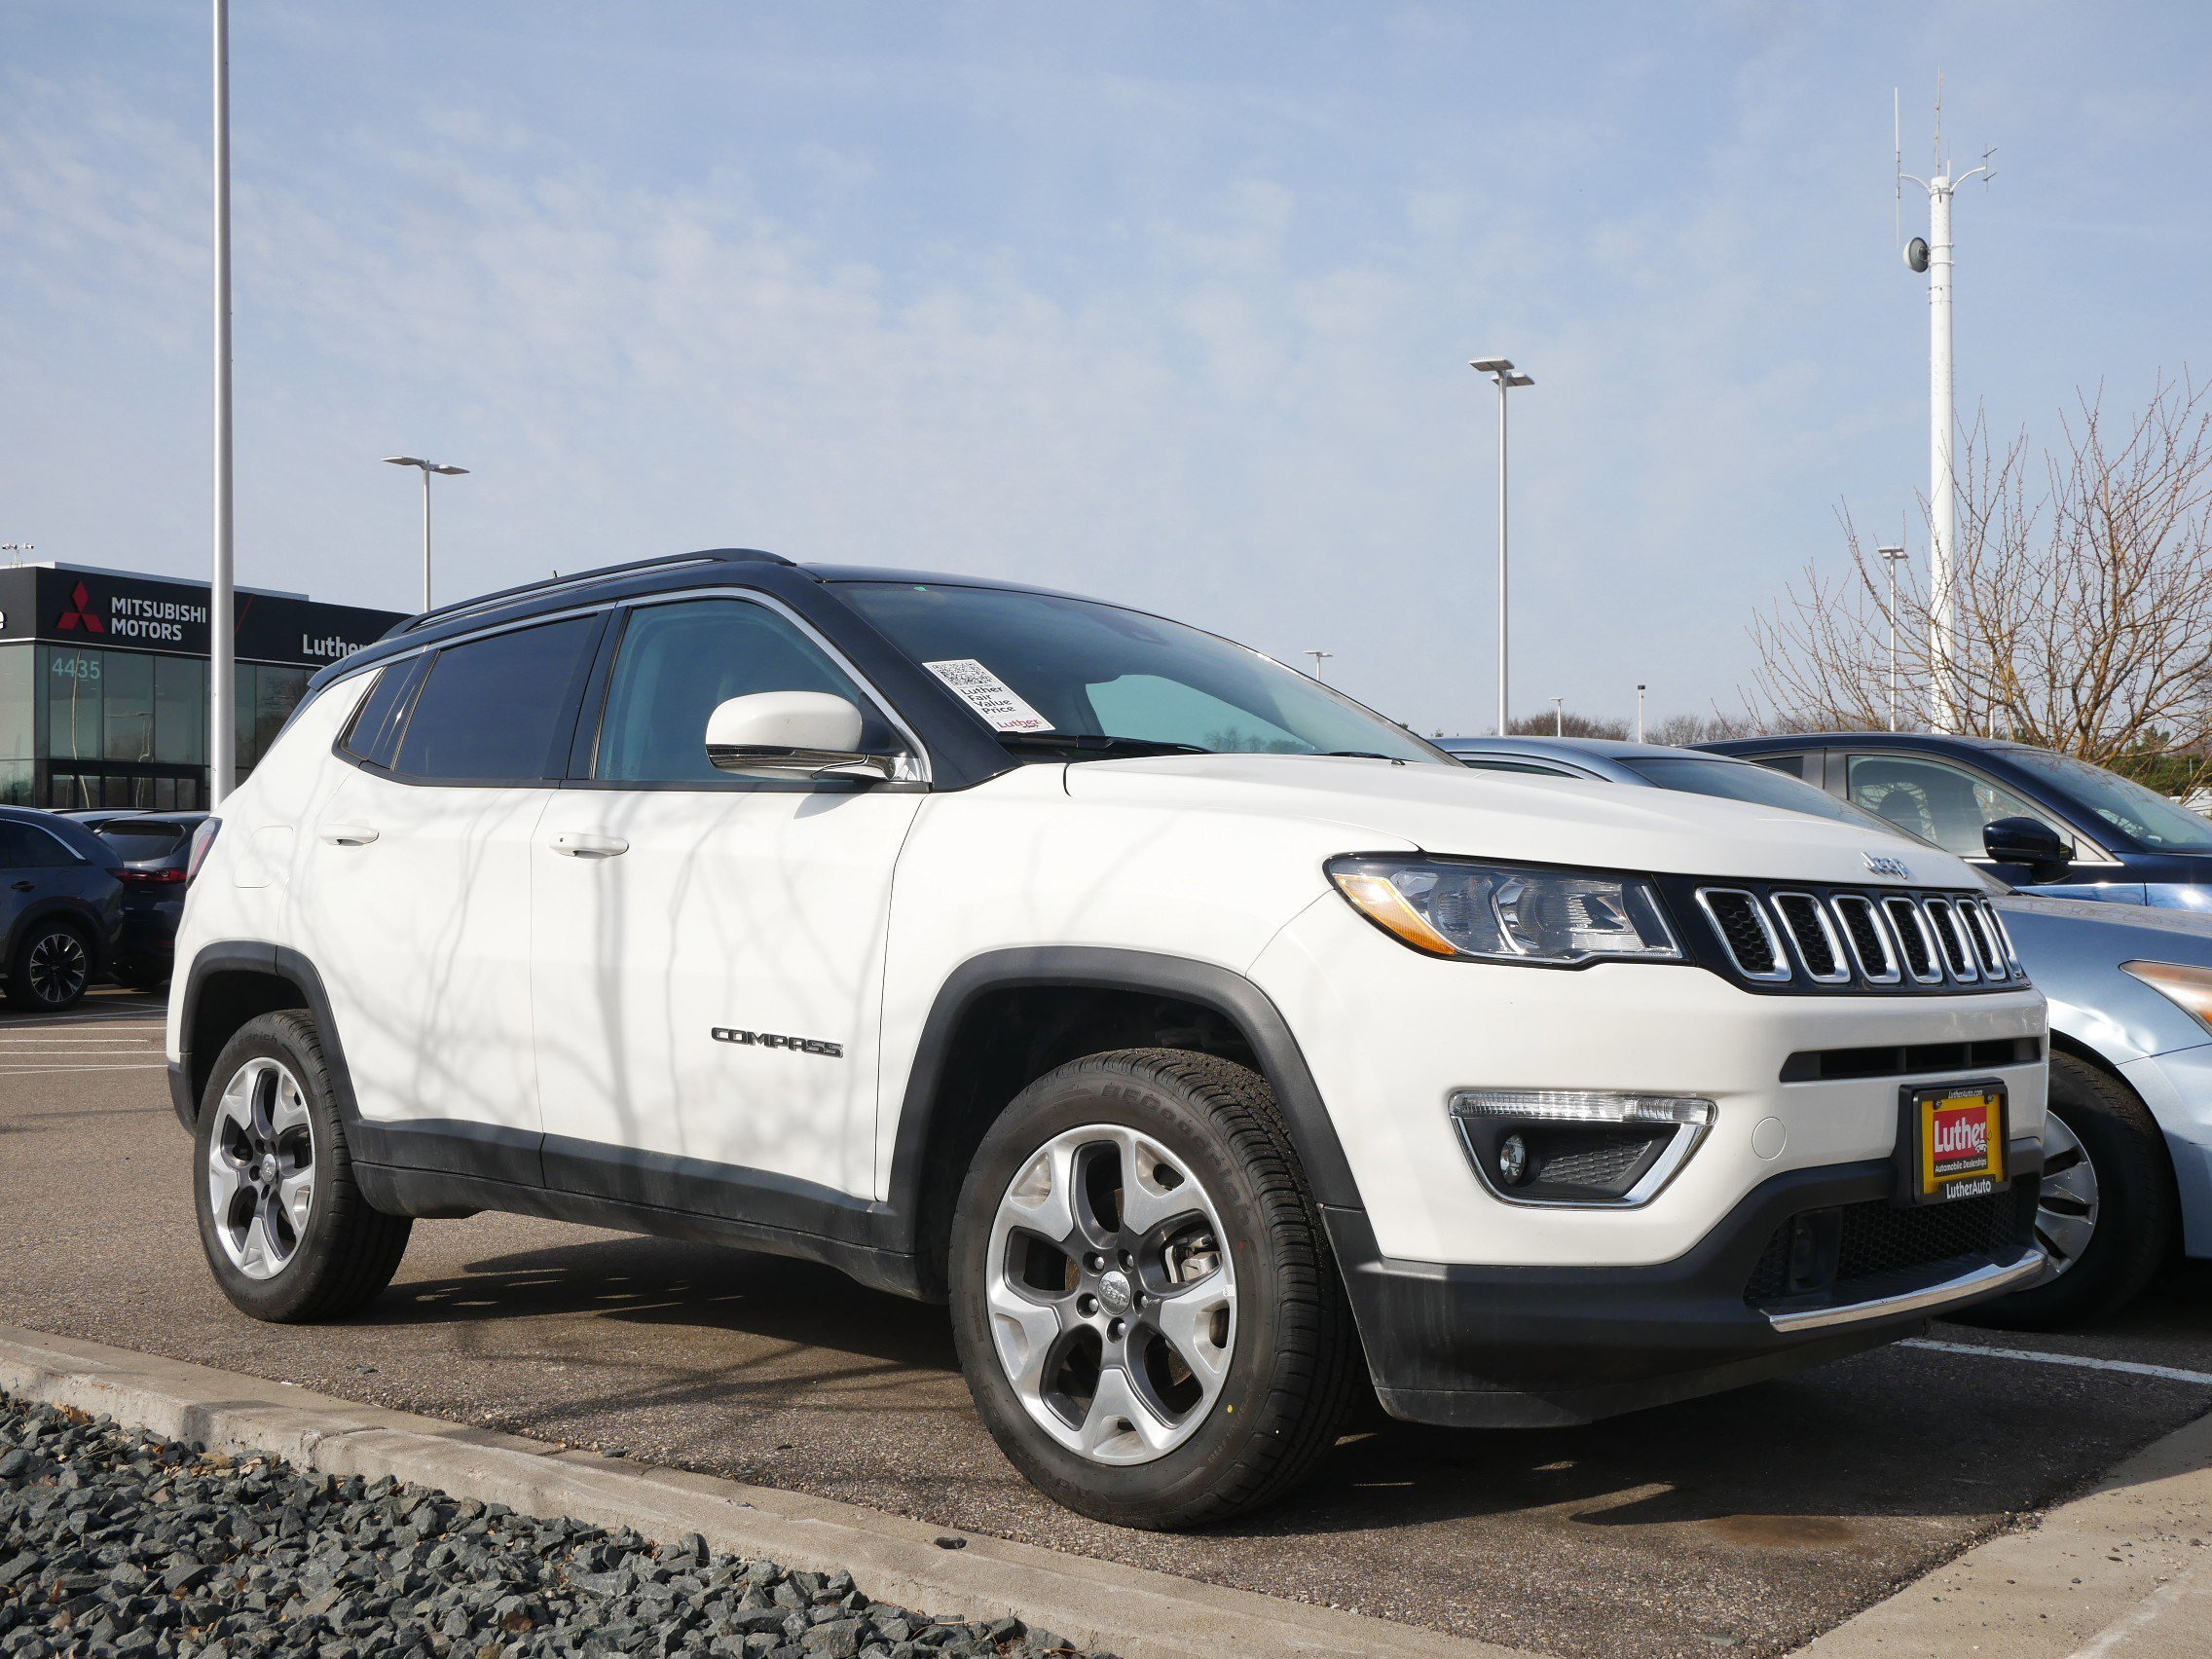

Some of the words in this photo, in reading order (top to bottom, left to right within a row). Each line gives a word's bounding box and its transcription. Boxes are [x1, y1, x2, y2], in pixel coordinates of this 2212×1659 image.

[111, 596, 206, 624] MITSUBISHI
[111, 617, 182, 641] MOTORS
[52, 657, 100, 680] 4435
[960, 685, 1003, 695] Luther
[968, 693, 992, 702] Fair
[974, 699, 1013, 708] Value
[981, 706, 1016, 715] Price
[996, 719, 1039, 729] Luther
[1860, 851, 1909, 880] Jeep
[711, 1026, 843, 1059] COMPASS
[1948, 1089, 1983, 1099] LutherAuto.com
[1935, 1117, 1986, 1153] Luther
[1935, 1161, 1962, 1173] Automobile
[1963, 1158, 1987, 1169] Dealerships
[1946, 1179, 1992, 1199] LutherAuto
